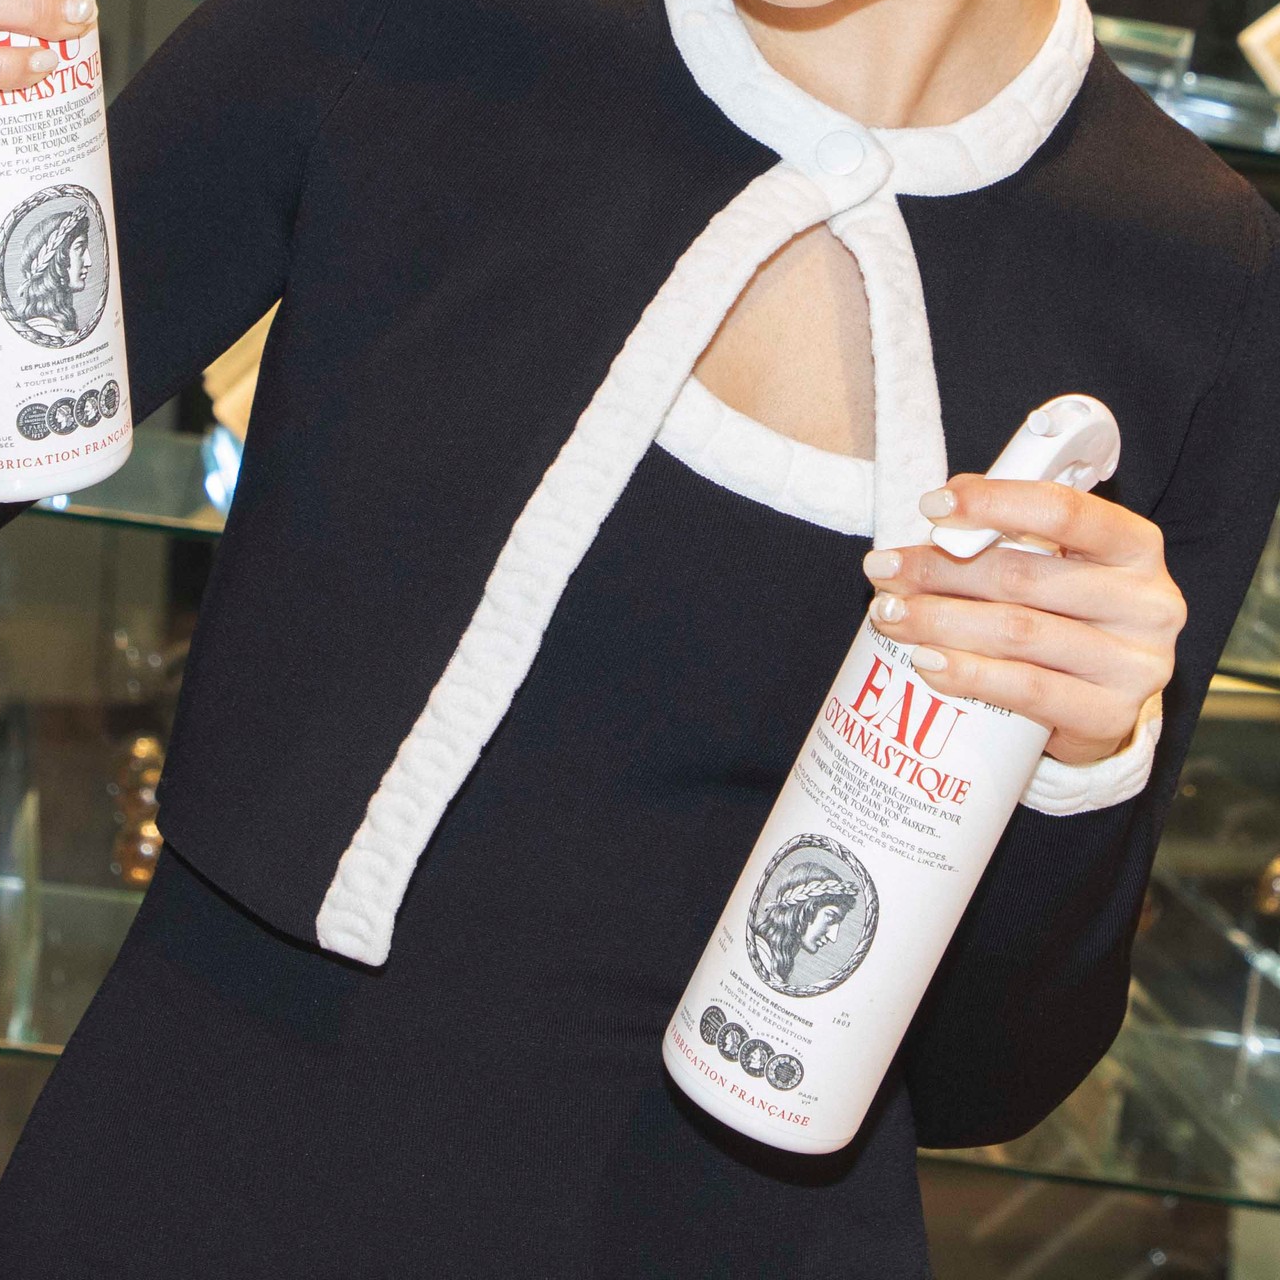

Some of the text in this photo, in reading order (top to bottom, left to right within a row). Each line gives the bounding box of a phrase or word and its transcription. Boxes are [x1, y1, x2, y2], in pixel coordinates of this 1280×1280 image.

[0, 108, 86, 136] CHAUSSURES DE SPORT.
[12, 135, 23, 145] DE
[26, 130, 46, 142] NEUF
[49, 125, 68, 138] DANS
[70, 119, 83, 132] VOS
[15, 132, 80, 155] POUR TOUJOURS.
[14, 165, 42, 176] YOUR
[43, 153, 86, 170] SNEAKERS
[16, 157, 30, 165] FIX
[32, 153, 52, 163] FOR
[53, 146, 75, 158] YOUR
[77, 137, 98, 152] SPORTS
[30, 167, 74, 181] FOREVER.
[20, 364, 33, 372] LES
[34, 361, 51, 370] PLUS
[51, 356, 75, 367] HAUTES
[24, 377, 58, 388] TOUTES
[60, 373, 75, 382] LES
[849, 653, 969, 761] EAU
[825, 696, 972, 805] GYMNASTIQUE
[830, 784, 890, 828] POUR TOUJOURS.
[831, 760, 911, 816] CHAUSSURES DE SPORT.
[833, 773, 842, 785] DE
[843, 781, 862, 798] NEUF
[862, 794, 883, 811] DANS
[884, 806, 900, 821] VOS
[834, 748, 869, 780] OLFACTIVE
[869, 775, 939, 817] RAFRAÎCHISSANTE
[939, 809, 963, 826] POUR
[805, 787, 821, 805] MAKE
[821, 802, 841, 820] YOUR
[841, 818, 887, 849] SNEAKERS
[888, 844, 916, 861] SMELL
[917, 857, 937, 869] LIKE
[825, 795, 837, 807] FIX
[837, 804, 854, 819] FOR
[855, 816, 879, 834] YOUR
[880, 831, 916, 852] SPORTS
[825, 817, 866, 848] FOREVER.
[724, 985, 746, 1007] TOUTES
[748, 1005, 761, 1018] LES
[762, 1016, 813, 1045] EXPOSITIONS
[729, 969, 739, 980] LES
[739, 976, 751, 990] PLUS
[750, 985, 770, 1004] HAUTES
[769, 1000, 814, 1028] RÉCOMPENSES
[730, 1083, 811, 1127] FRANÇAISE
